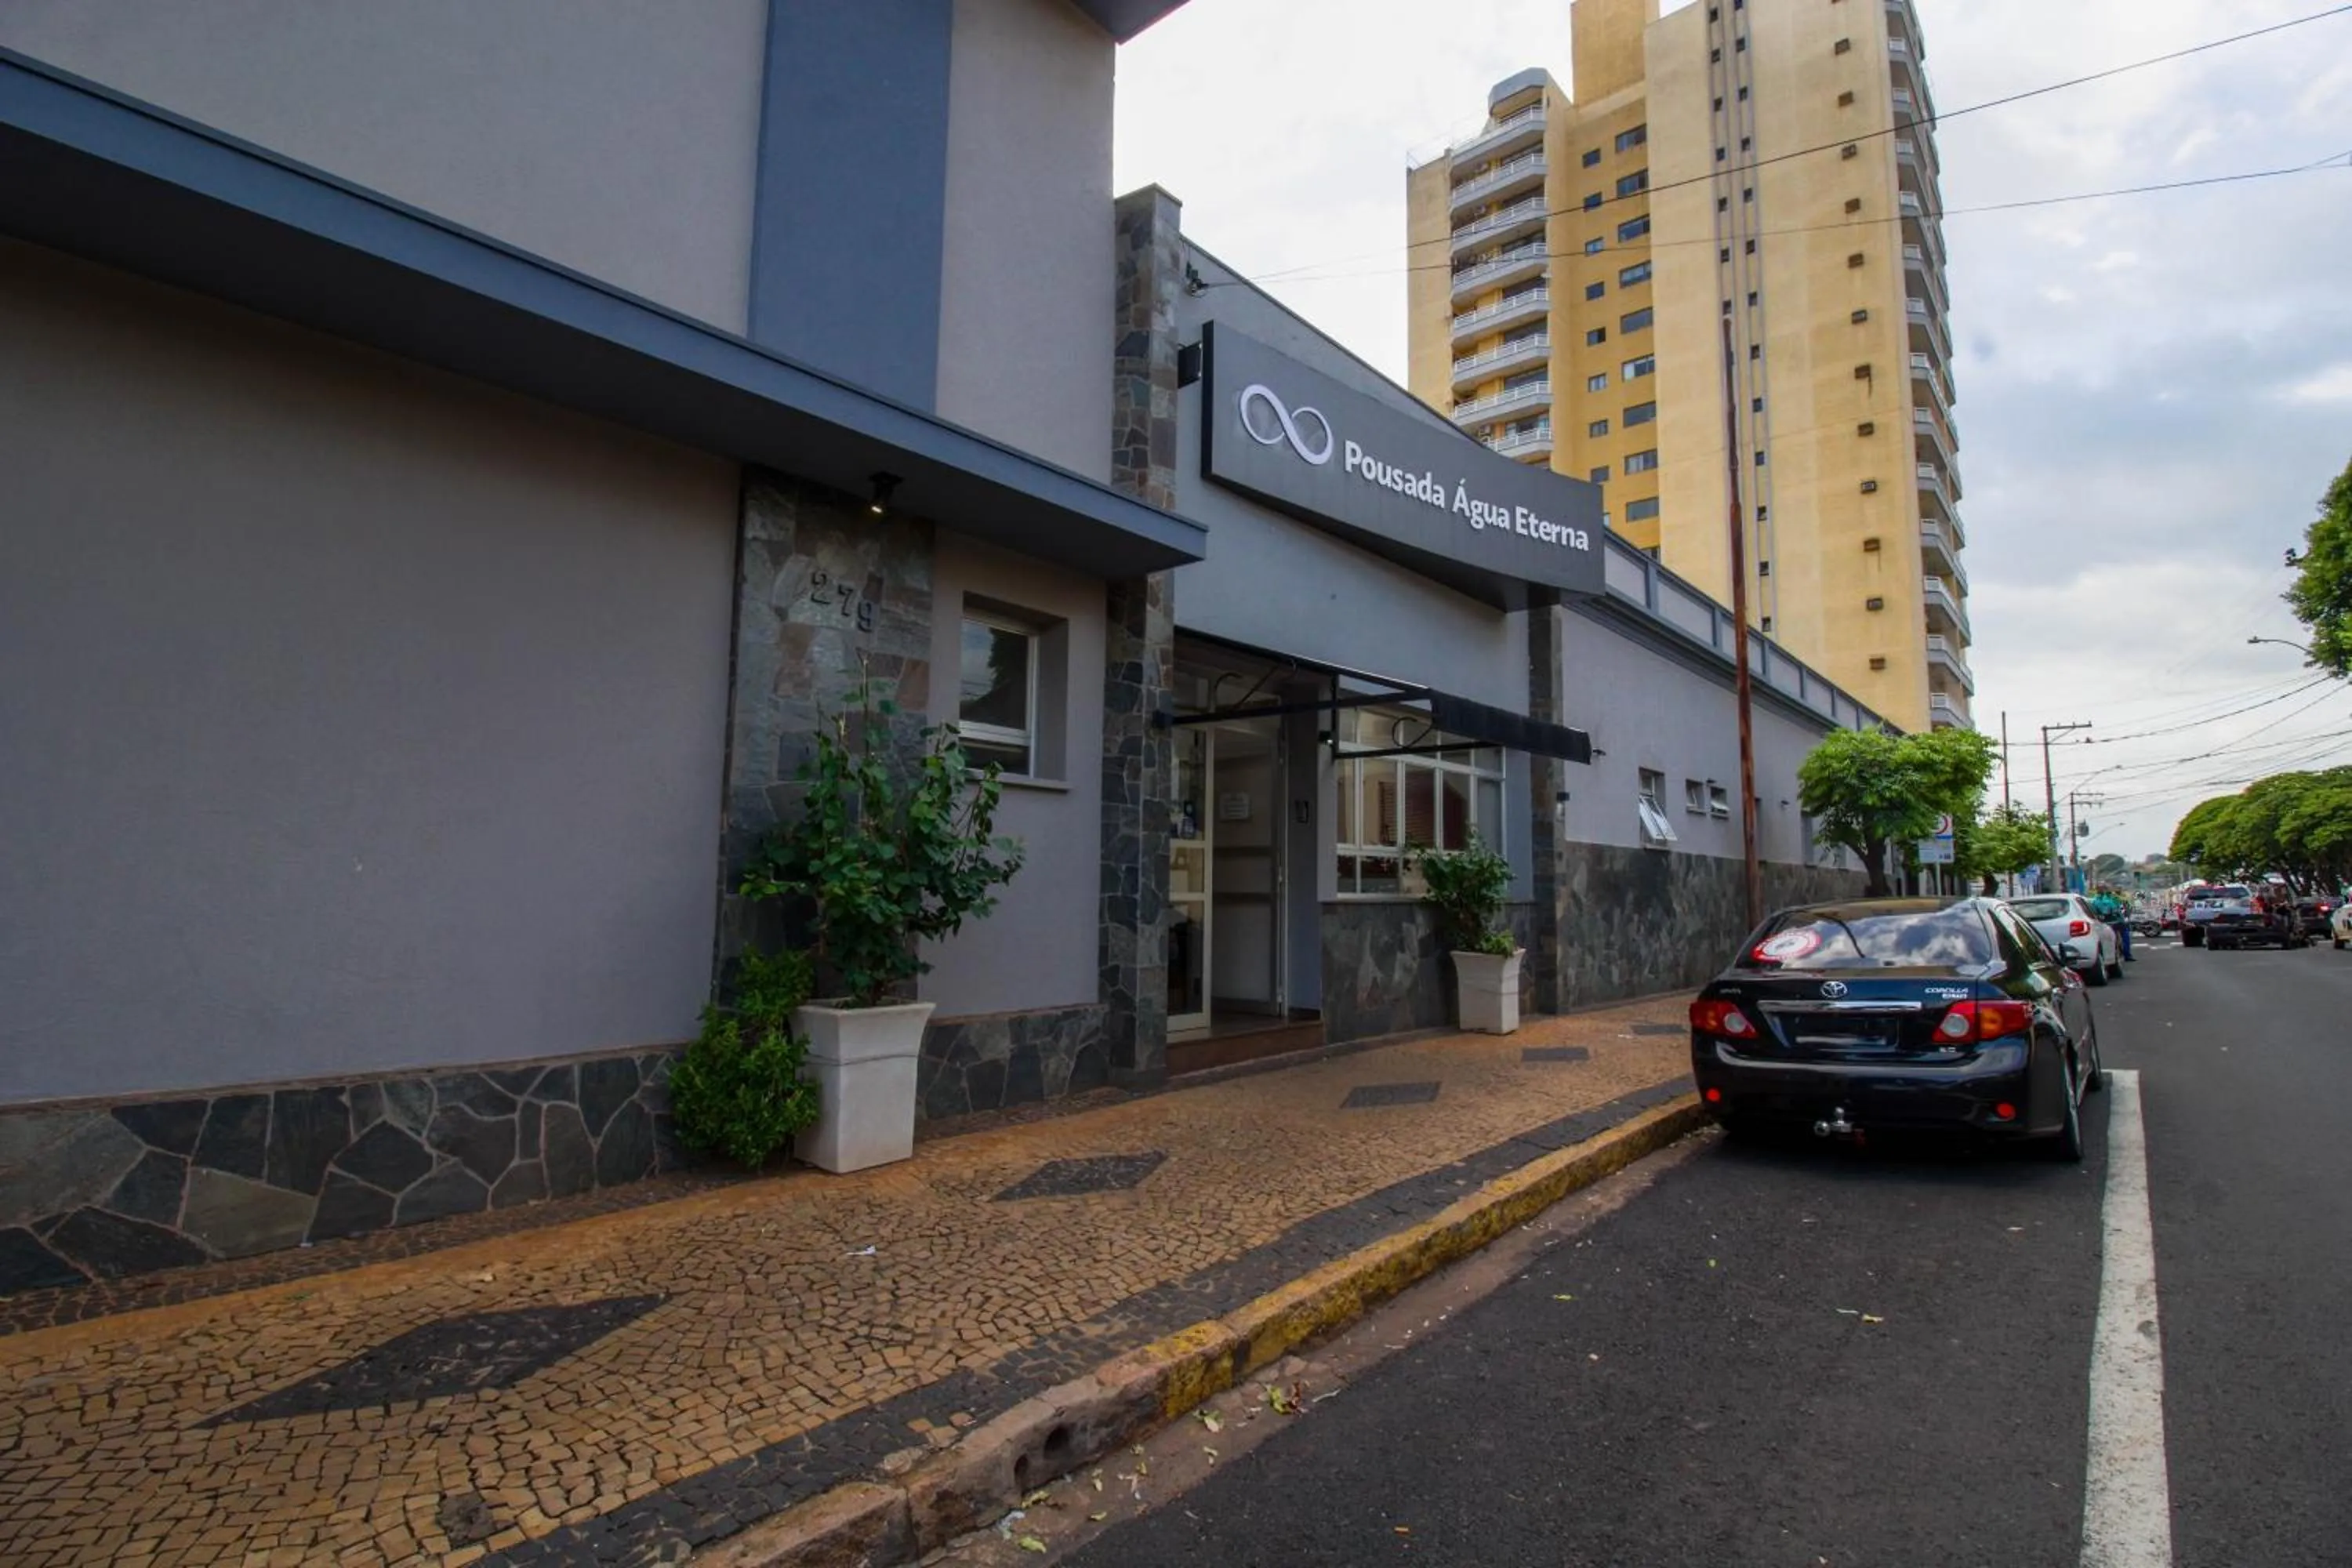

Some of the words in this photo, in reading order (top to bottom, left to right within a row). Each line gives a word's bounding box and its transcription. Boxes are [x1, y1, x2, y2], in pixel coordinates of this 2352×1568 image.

[1345, 440, 1446, 509] Pousada
[1452, 477, 1511, 530] Água
[1515, 506, 1590, 552] Eterna
[811, 568, 873, 633] 279
